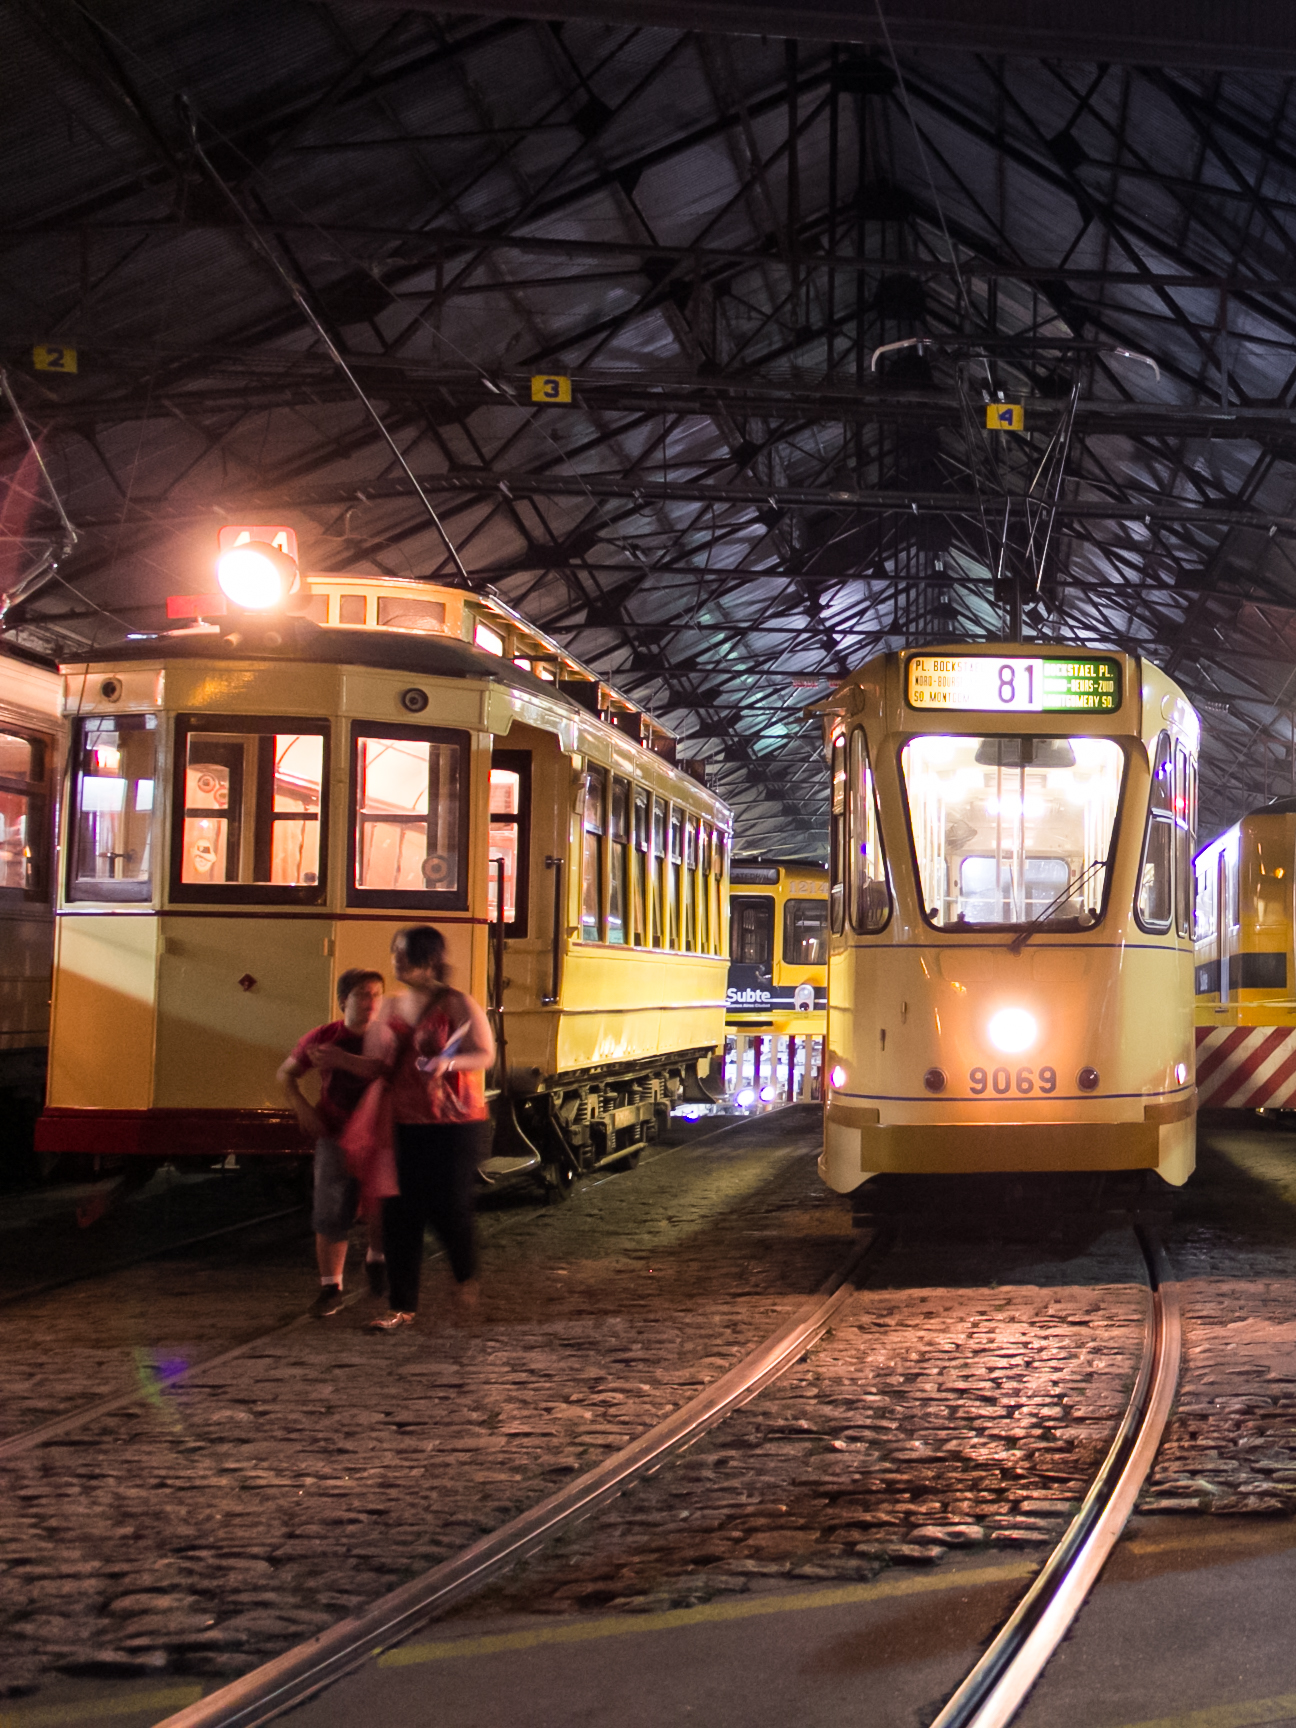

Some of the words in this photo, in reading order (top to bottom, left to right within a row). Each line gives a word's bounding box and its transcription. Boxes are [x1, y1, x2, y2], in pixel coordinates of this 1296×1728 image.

[46, 348, 65, 368] 2
[543, 379, 560, 398] 3
[999, 408, 1013, 426] 4
[915, 660, 930, 672] PL.
[1098, 665, 1113, 677] PL.
[998, 664, 1034, 704] 81
[726, 987, 771, 1002] Subte
[969, 1066, 1057, 1095] 9069
